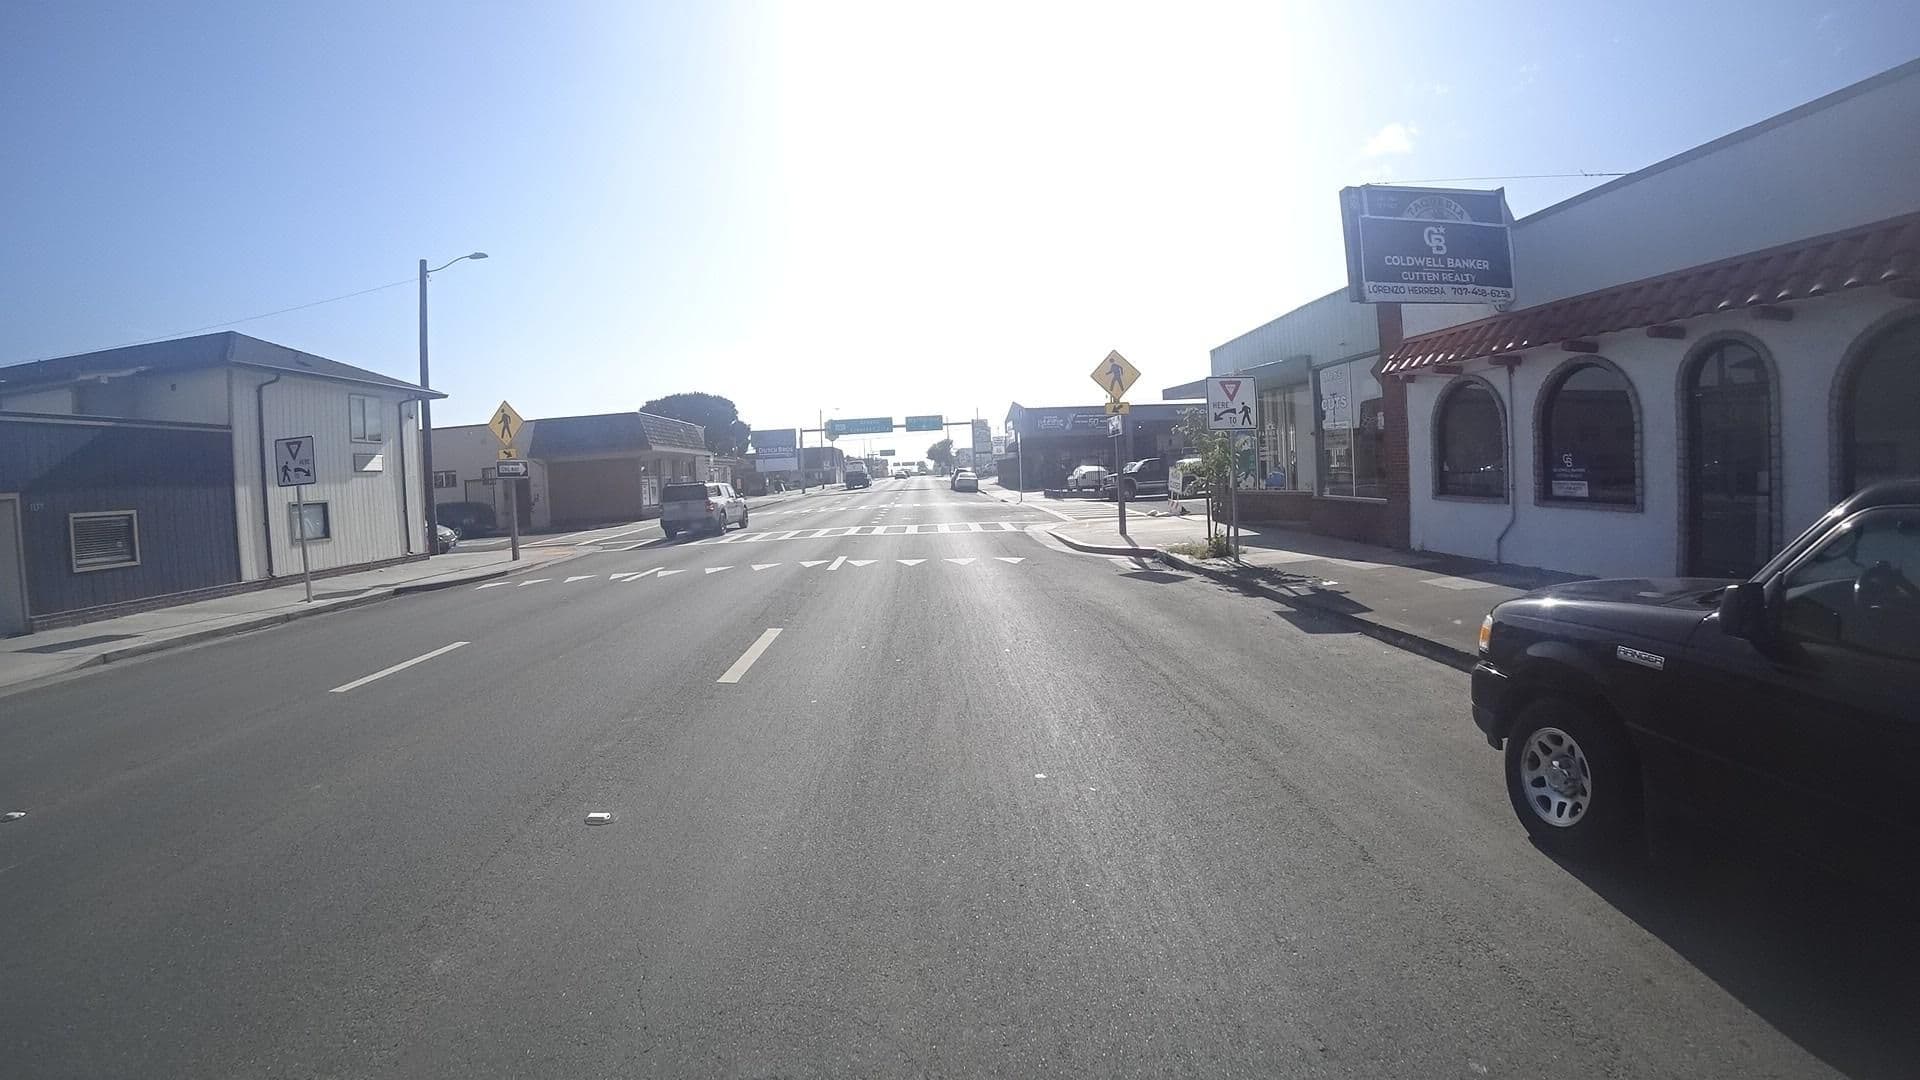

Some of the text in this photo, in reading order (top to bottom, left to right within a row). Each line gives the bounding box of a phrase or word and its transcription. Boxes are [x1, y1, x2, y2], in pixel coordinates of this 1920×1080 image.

[1384, 255, 1490, 270] COLDWELL BANKER
[1401, 271, 1477, 283] CUTTEN REALTY
[1367, 284, 1406, 295] LORENZO
[1407, 286, 1447, 296] HERRERA
[1212, 401, 1230, 409] HERE
[1321, 395, 1347, 410] CUTS
[1229, 416, 1237, 424] TO
[1618, 646, 1664, 665] RANGER
